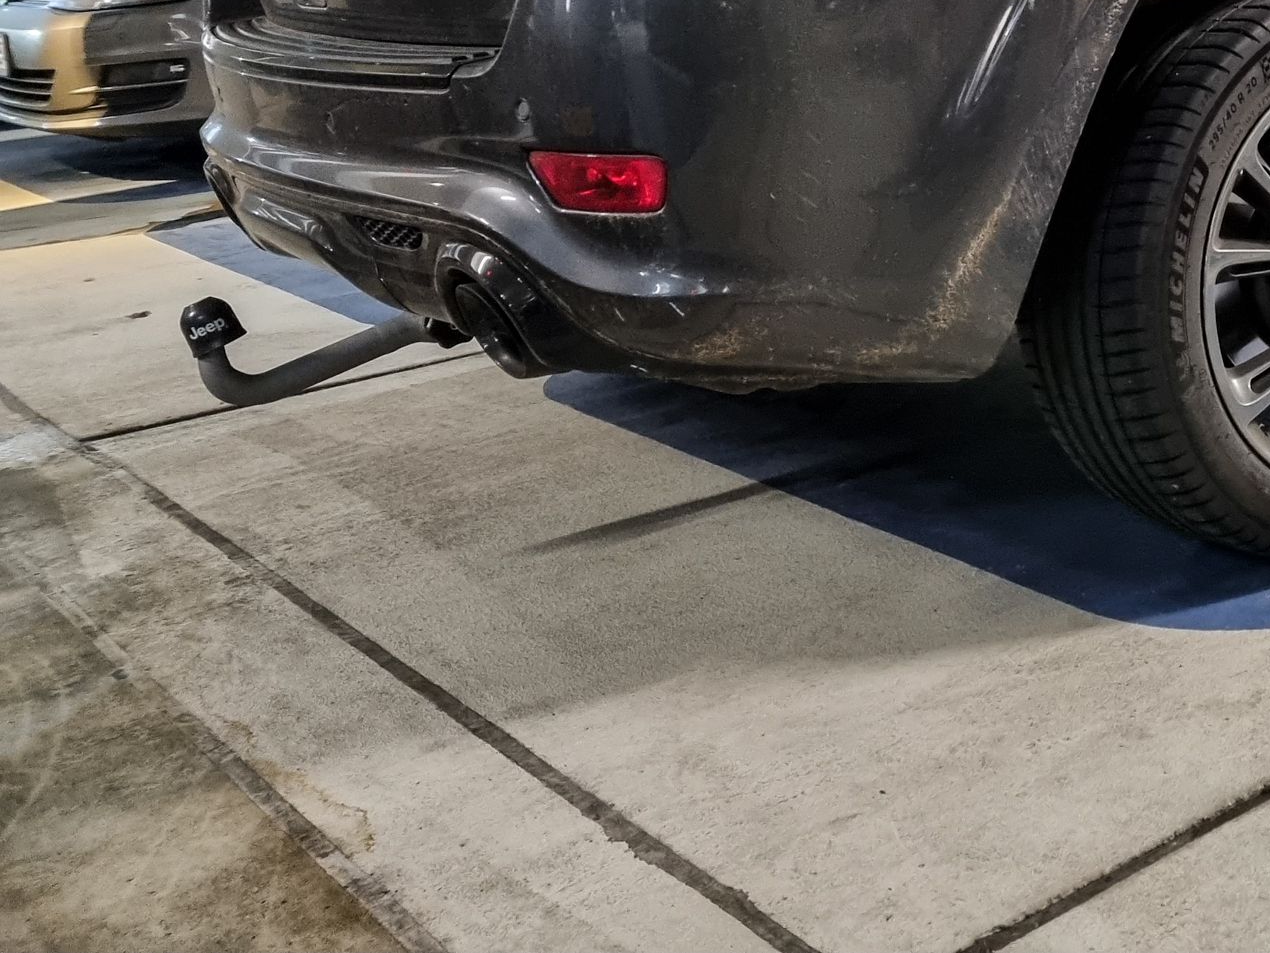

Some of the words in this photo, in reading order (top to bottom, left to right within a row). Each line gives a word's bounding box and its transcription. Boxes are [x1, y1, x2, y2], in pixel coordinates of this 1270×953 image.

[1208, 103, 1237, 150] 295/40
[1246, 77, 1258, 94] 20
[1169, 166, 1204, 344] MICHELIN
[189, 318, 225, 340] Jeep
